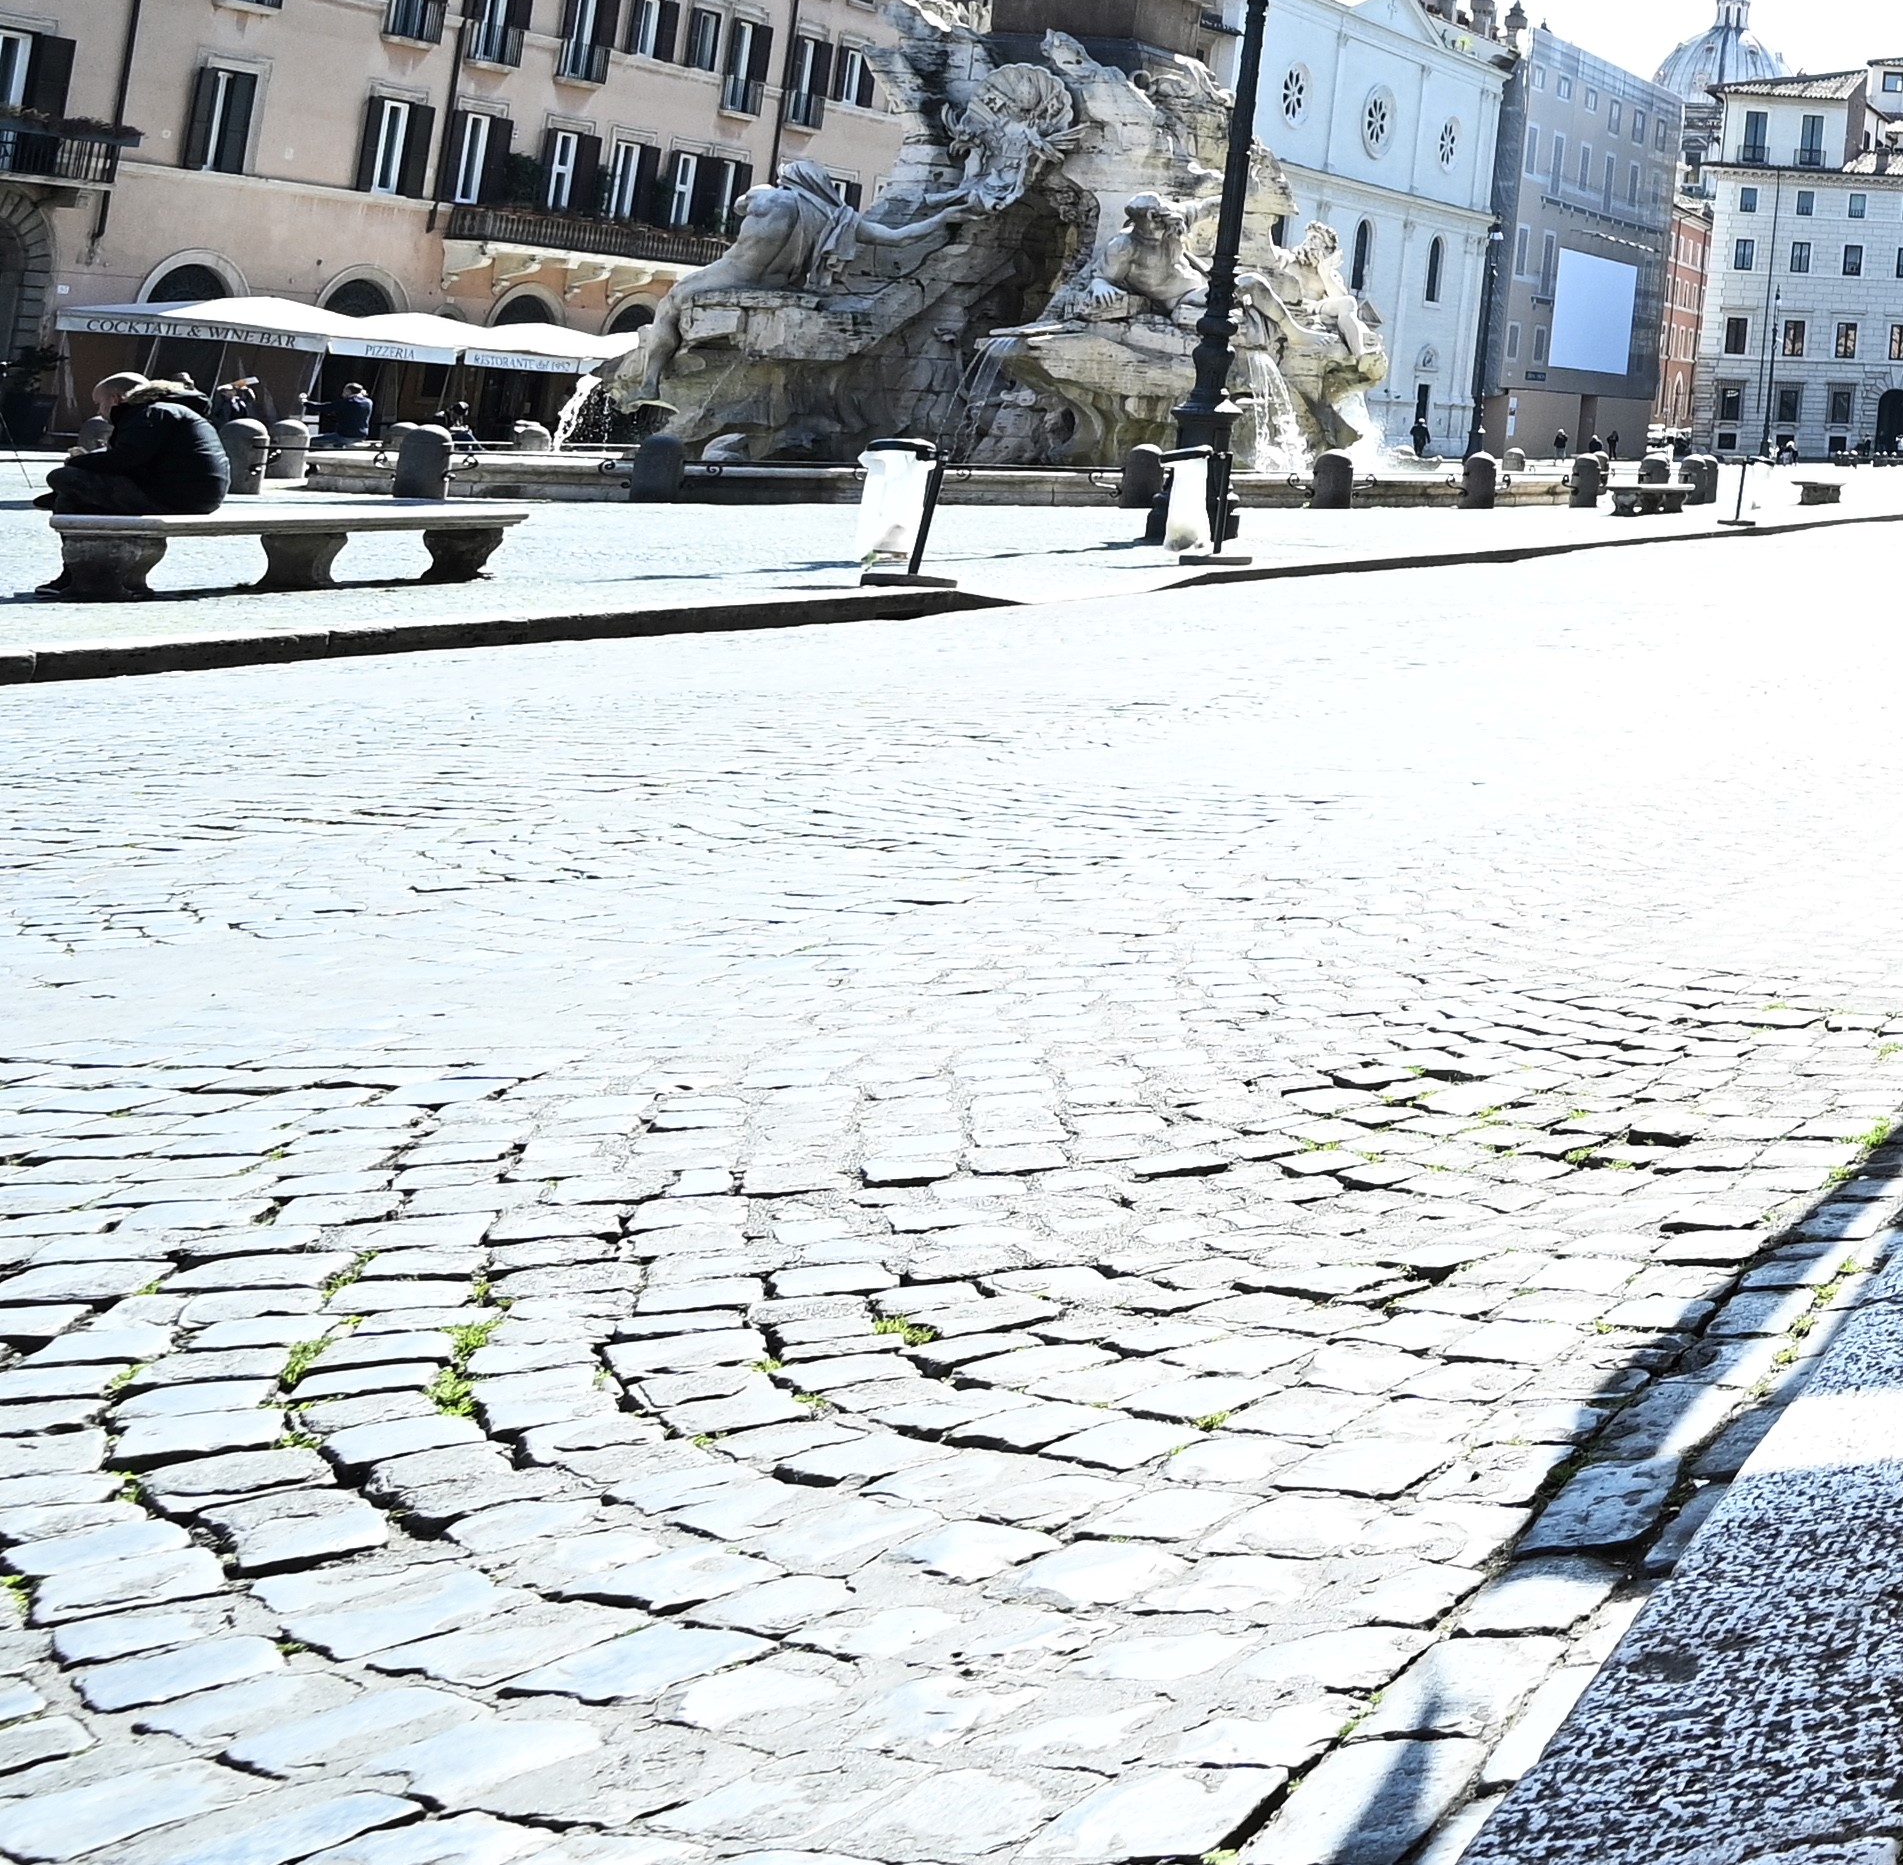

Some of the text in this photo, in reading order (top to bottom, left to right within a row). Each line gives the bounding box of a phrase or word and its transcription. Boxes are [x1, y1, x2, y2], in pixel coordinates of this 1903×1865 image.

[86, 319, 296, 348] COCKTAIL & WINE BAR
[364, 344, 415, 360] PIZZERIA
[473, 353, 534, 370] RISTORANTE
